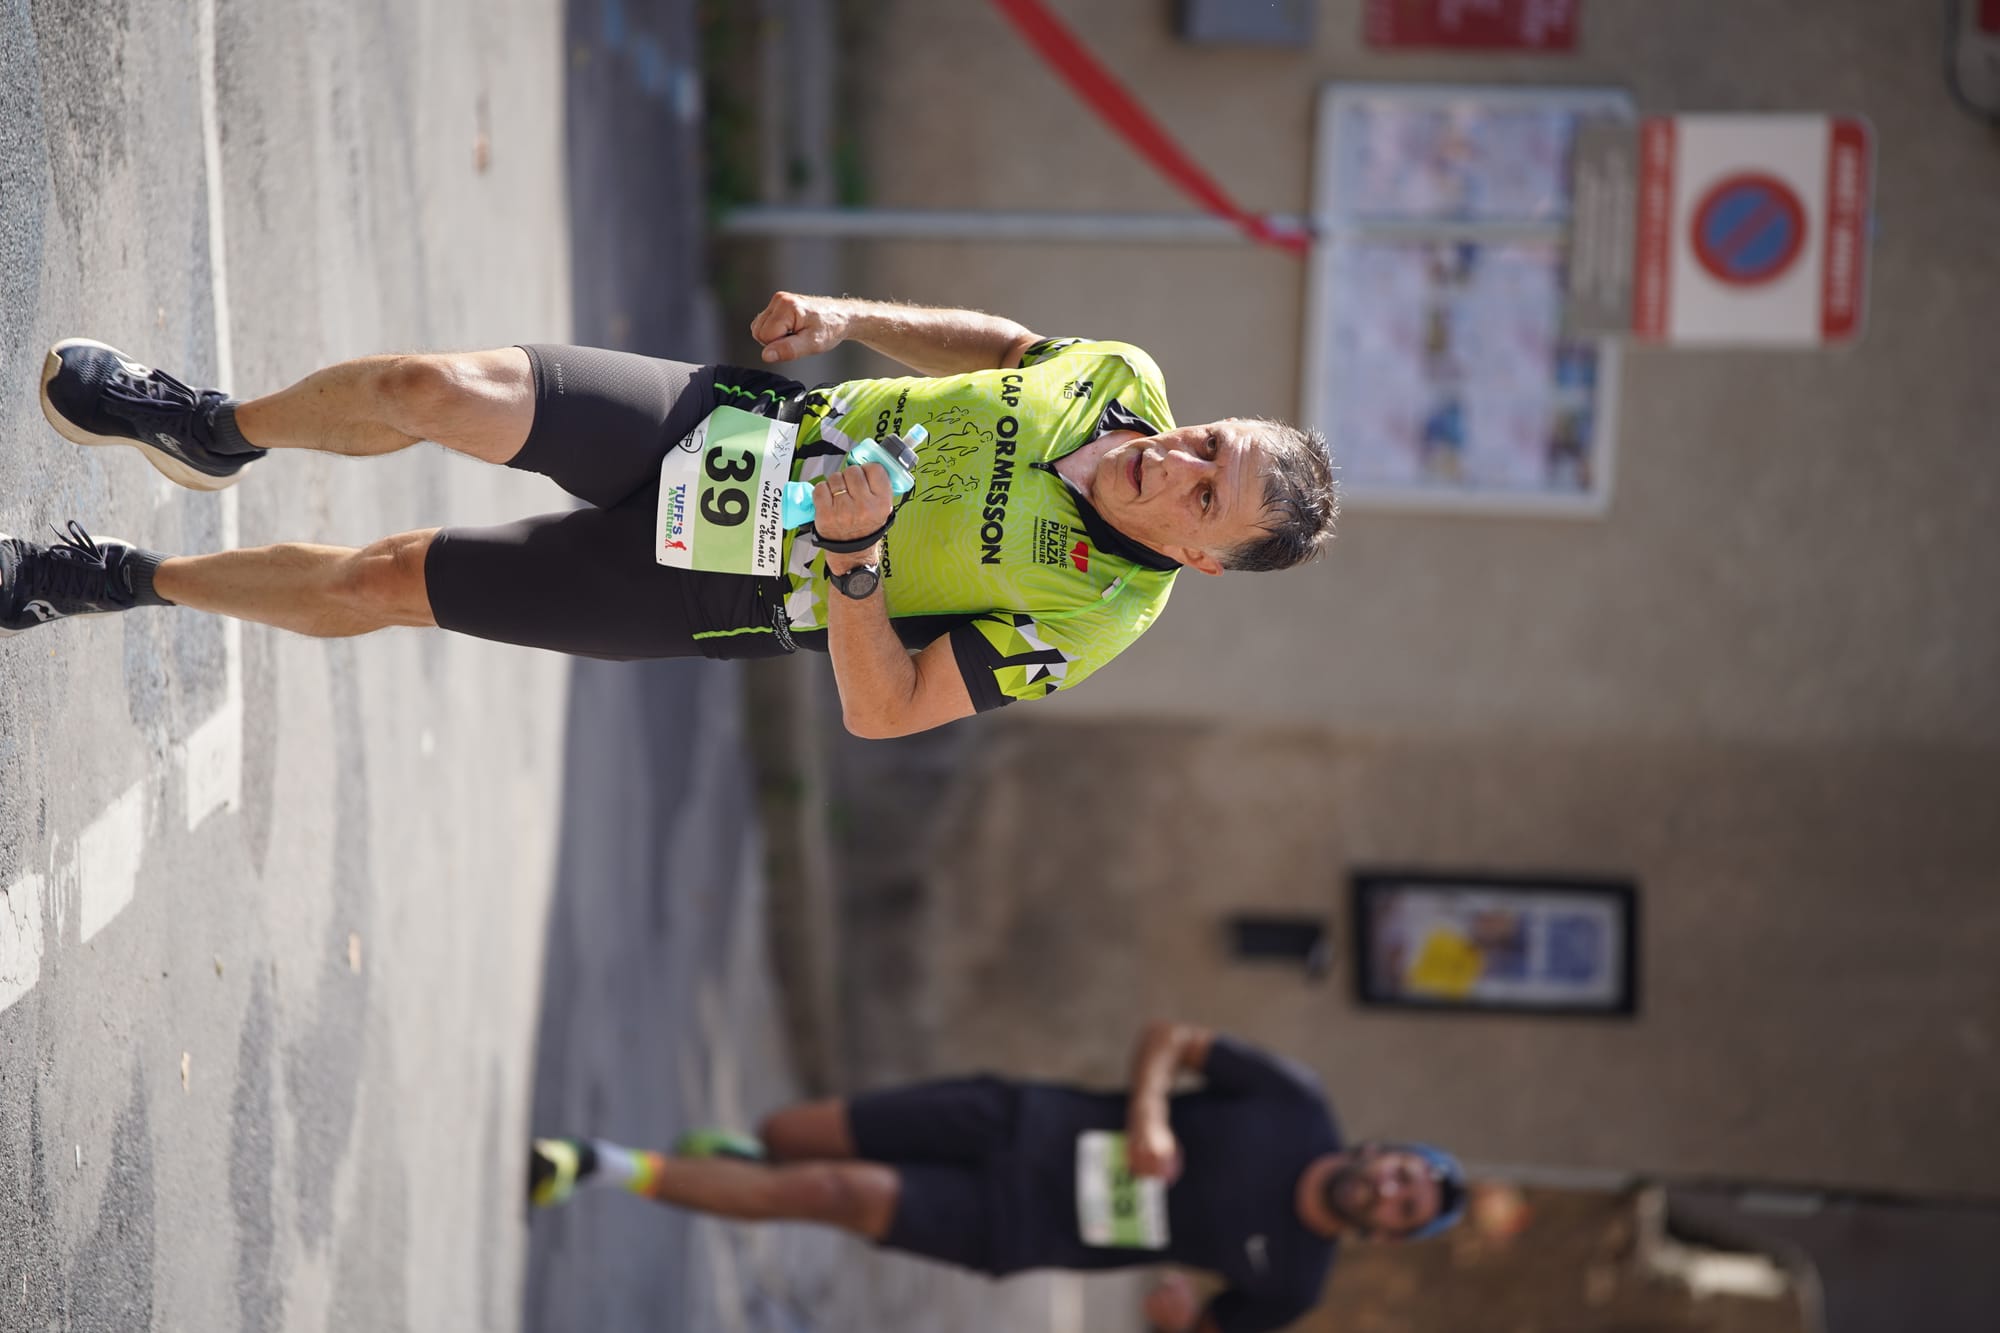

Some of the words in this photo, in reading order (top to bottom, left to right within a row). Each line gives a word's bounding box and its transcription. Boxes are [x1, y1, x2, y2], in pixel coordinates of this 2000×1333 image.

[1000, 374, 1023, 408] CAP
[700, 446, 756, 527] 39
[760, 480, 772, 519] vallées
[981, 415, 1020, 563] ORMESSON
[665, 487, 678, 539] Aventure
[672, 484, 687, 535] TUFF'S
[766, 487, 783, 540] Challenge
[757, 524, 769, 569] cévenoles
[768, 546, 778, 564] des
[1039, 518, 1047, 564] IMMOBILIER
[1046, 520, 1060, 565] PLAZA
[1059, 524, 1069, 569] STEPHANE
